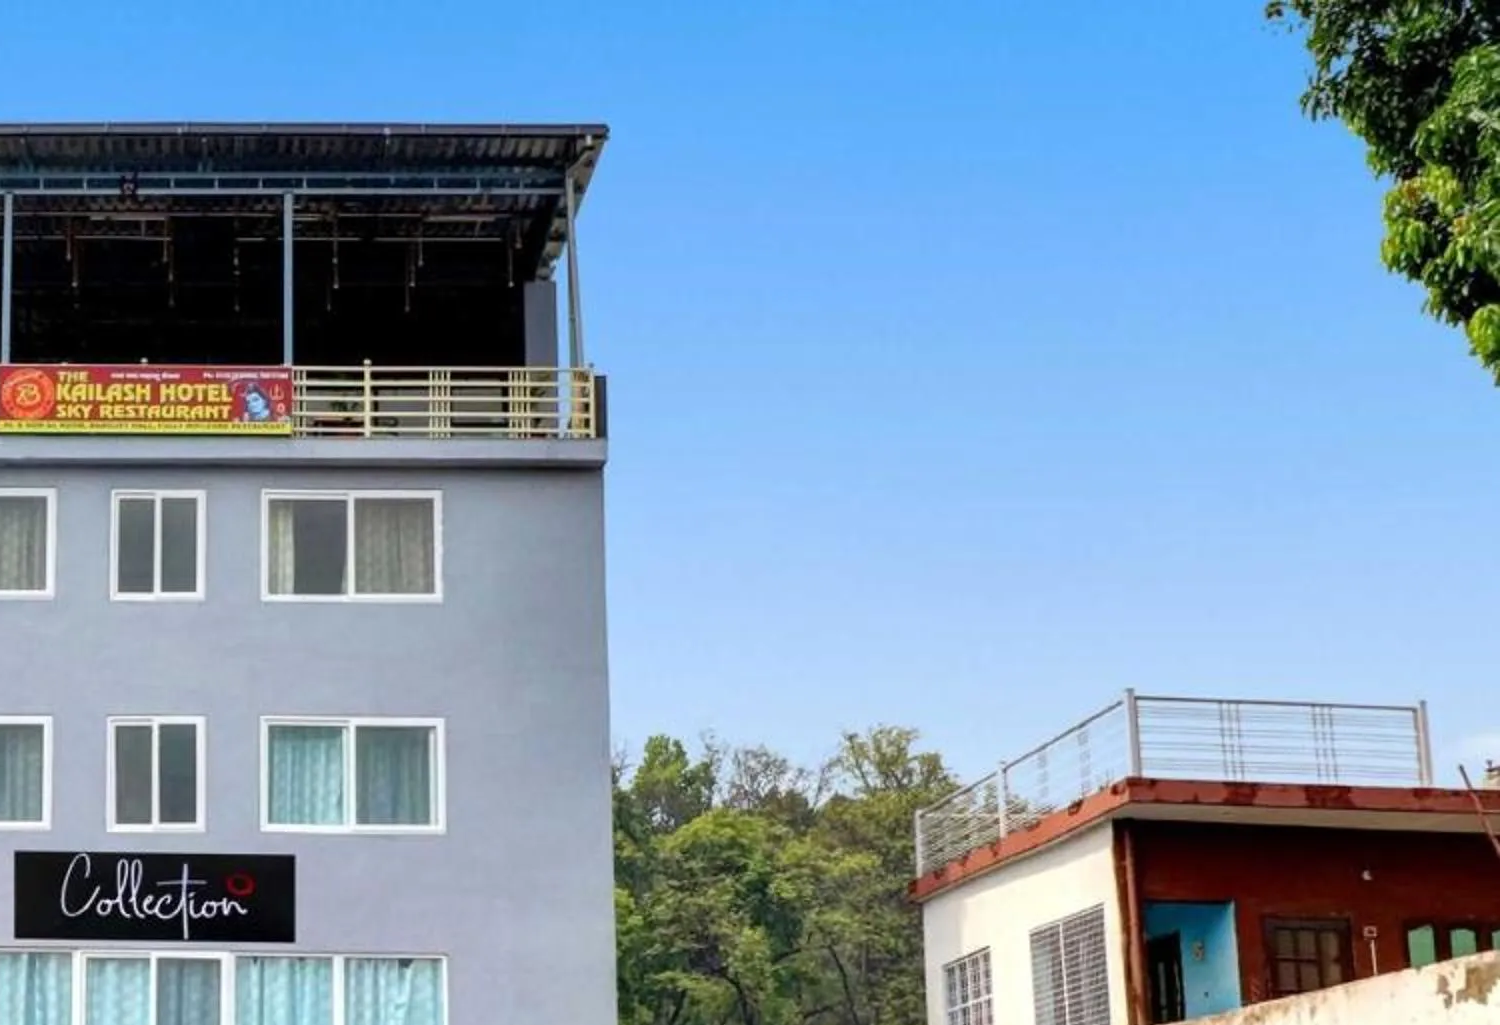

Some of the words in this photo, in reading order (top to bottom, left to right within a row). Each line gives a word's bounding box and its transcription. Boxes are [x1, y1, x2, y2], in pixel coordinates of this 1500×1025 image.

[57, 371, 89, 383] THE
[56, 383, 150, 403] KAILASH
[160, 384, 233, 403] HOTEL
[56, 404, 93, 419] SKY
[100, 404, 233, 419] RESTAURANT
[60, 852, 248, 940] Collection
